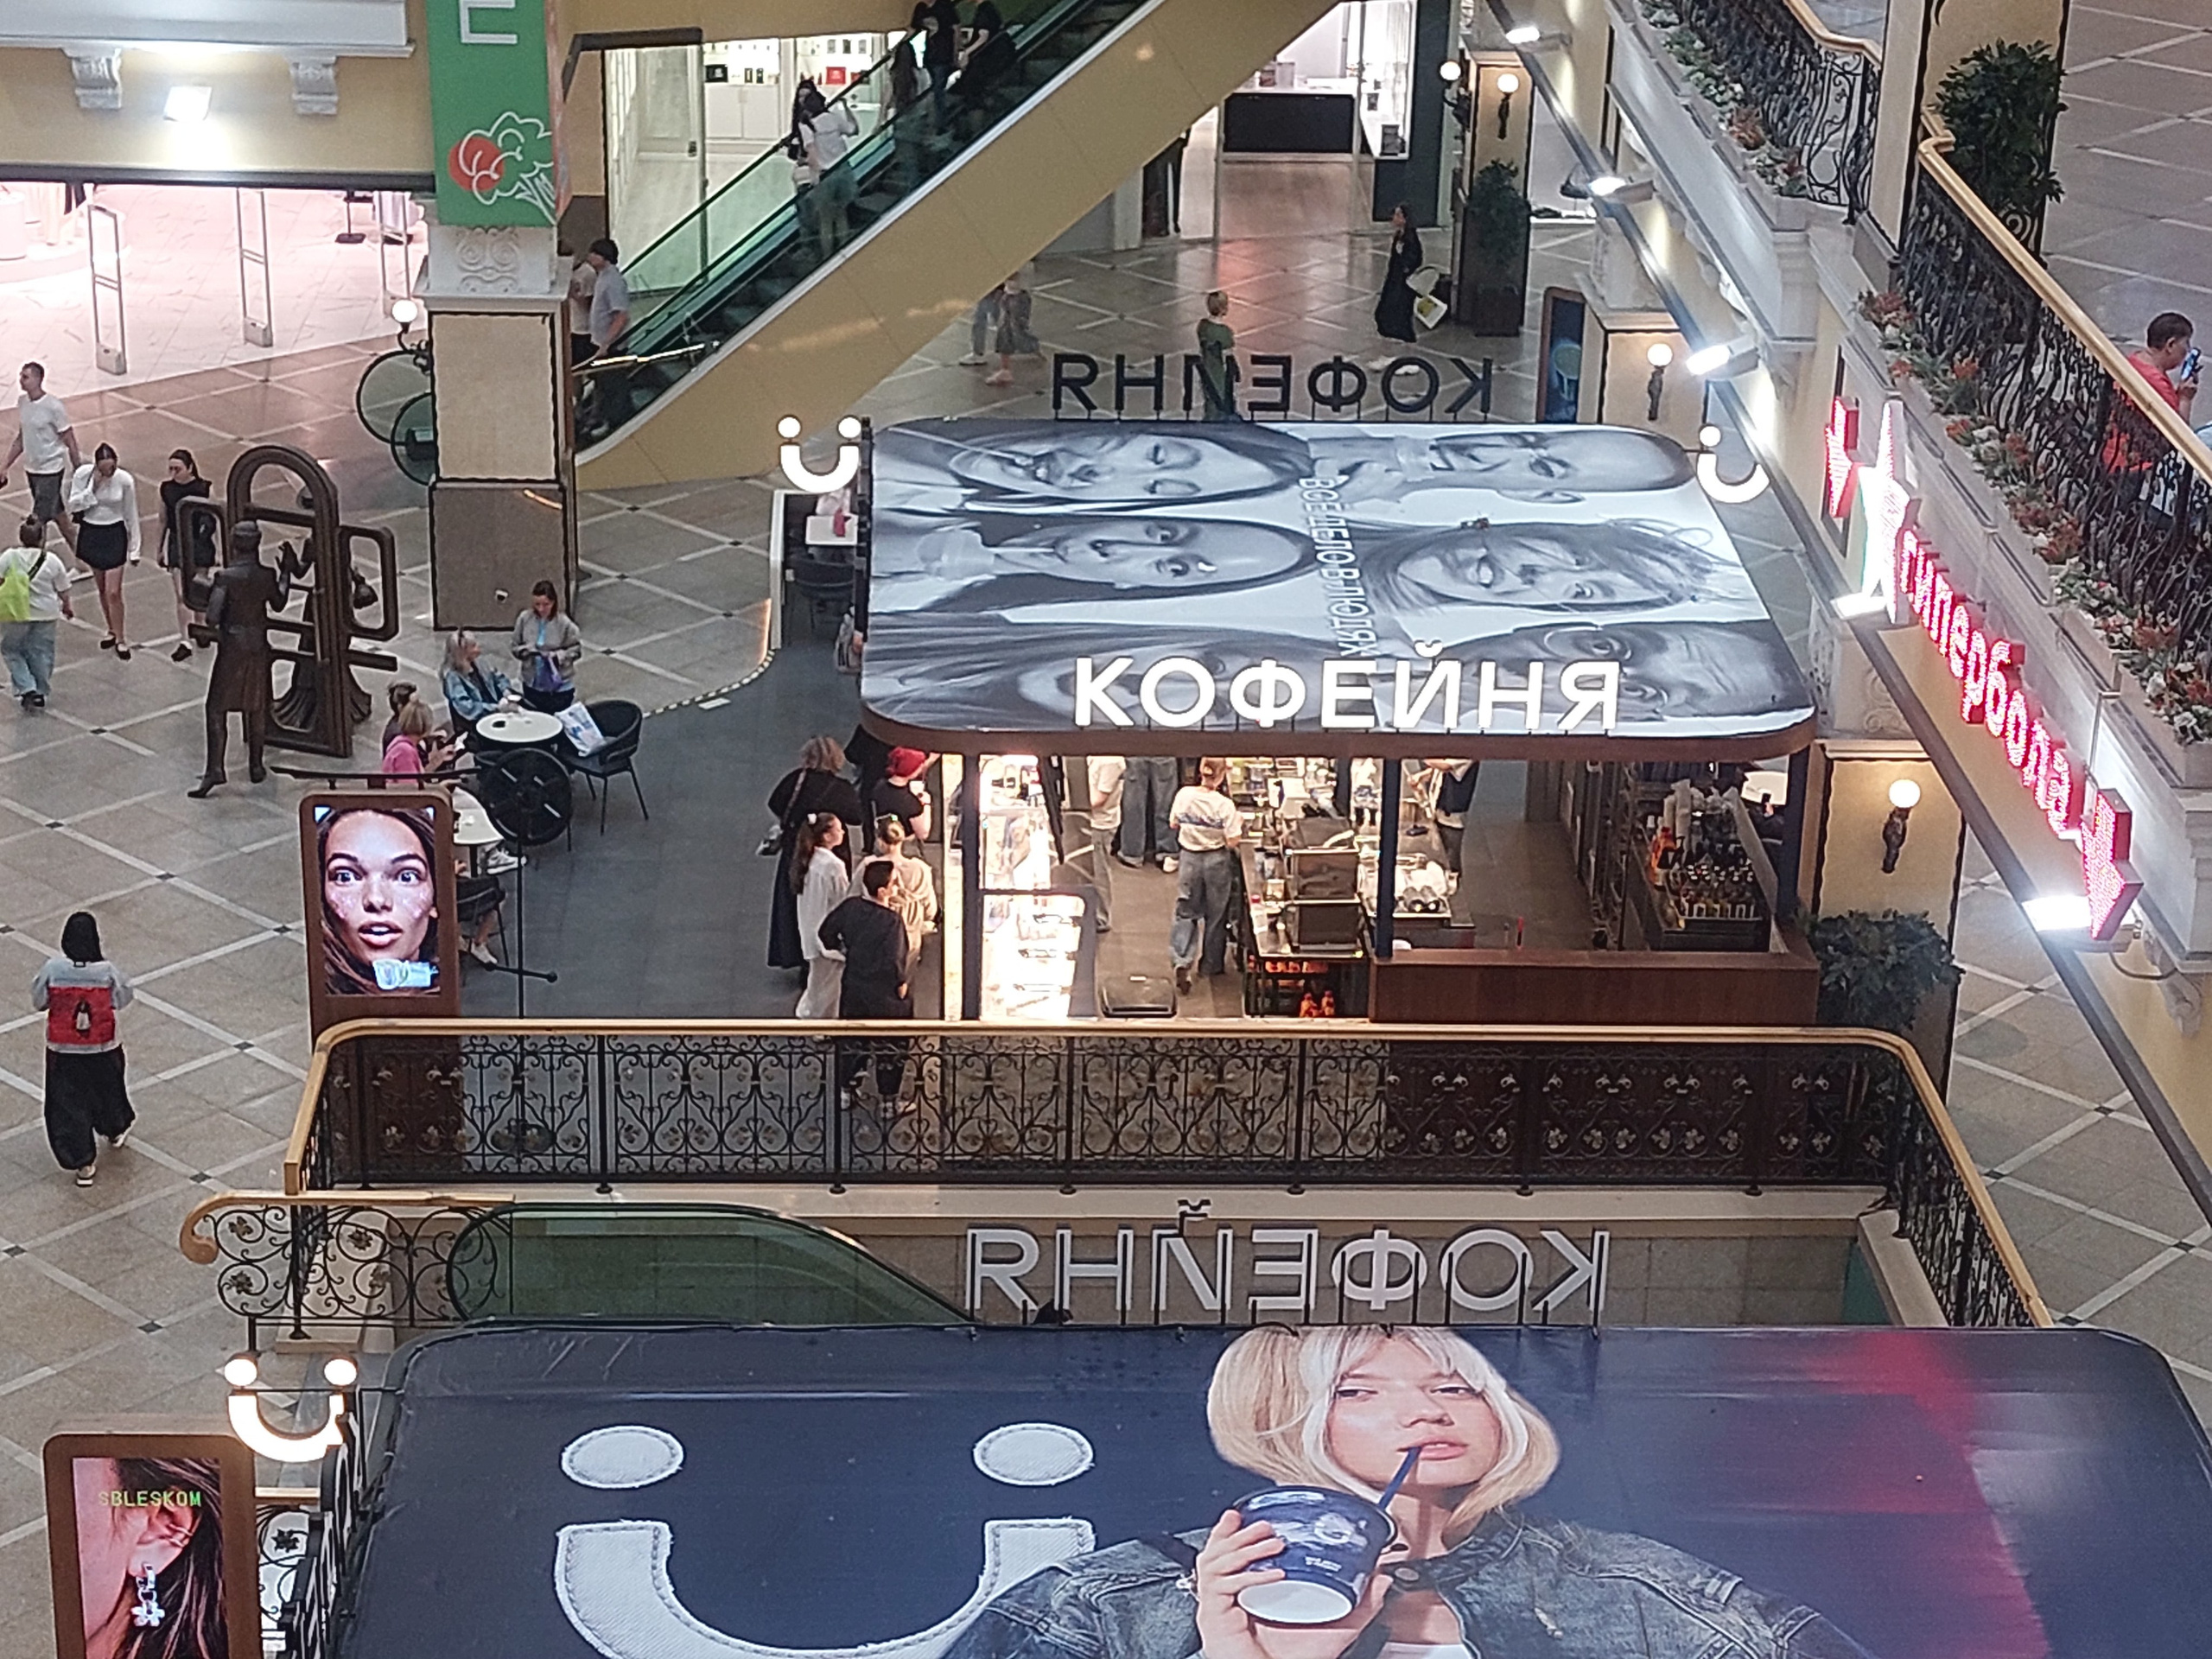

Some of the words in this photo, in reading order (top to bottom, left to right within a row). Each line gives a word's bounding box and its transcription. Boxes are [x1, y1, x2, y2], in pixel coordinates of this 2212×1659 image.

[1308, 513, 1357, 564] ДЕЛО
[1320, 567, 1362, 581] В
[1325, 584, 1381, 657] ЛЮДЯХ
[1074, 639, 1621, 729] КОФЕЙНЯ
